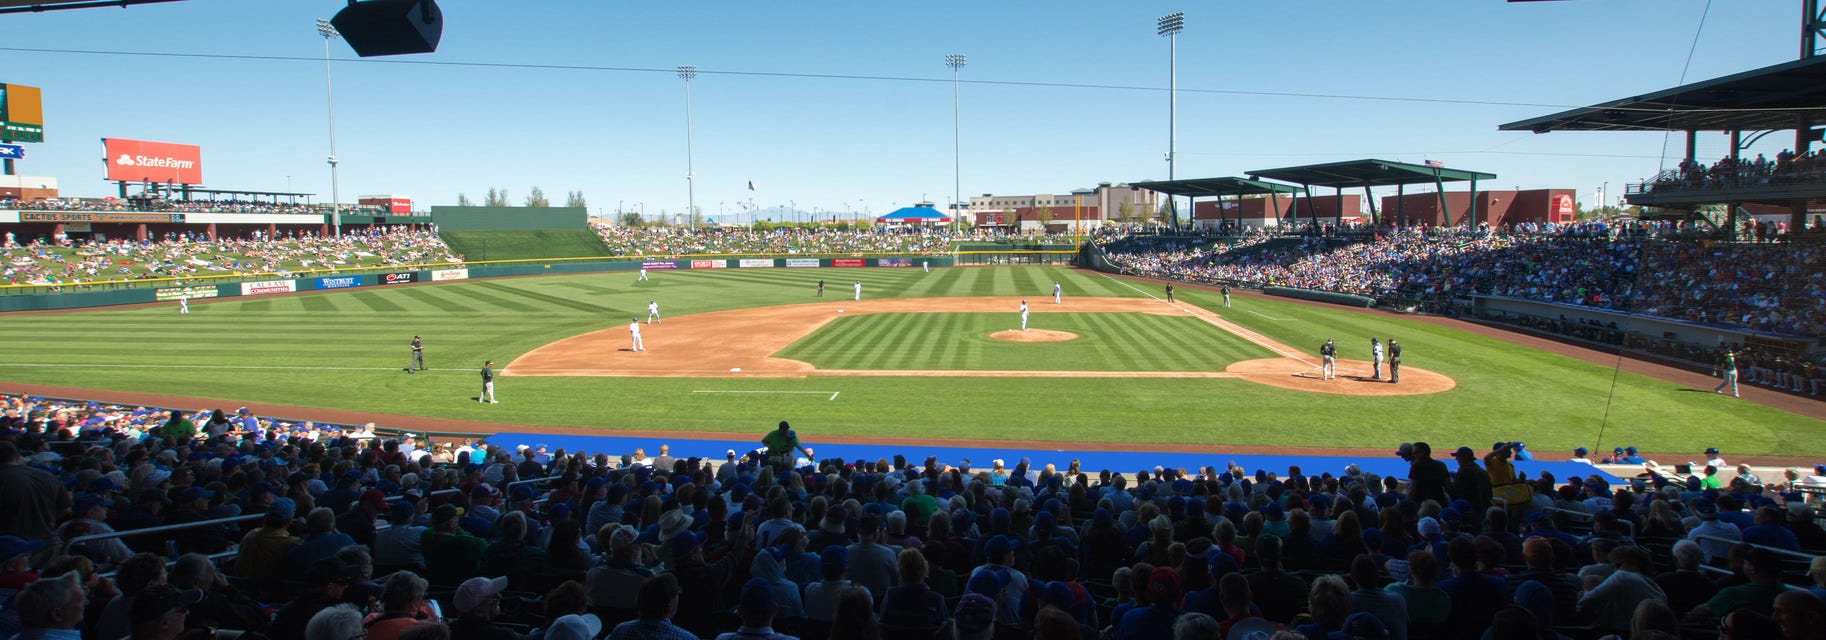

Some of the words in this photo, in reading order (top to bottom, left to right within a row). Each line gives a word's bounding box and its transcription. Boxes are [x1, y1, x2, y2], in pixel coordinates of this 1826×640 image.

[135, 155, 165, 168] State
[165, 157, 193, 169] Farm
[24, 212, 58, 221] CACTUS
[61, 213, 93, 221] SPORTS
